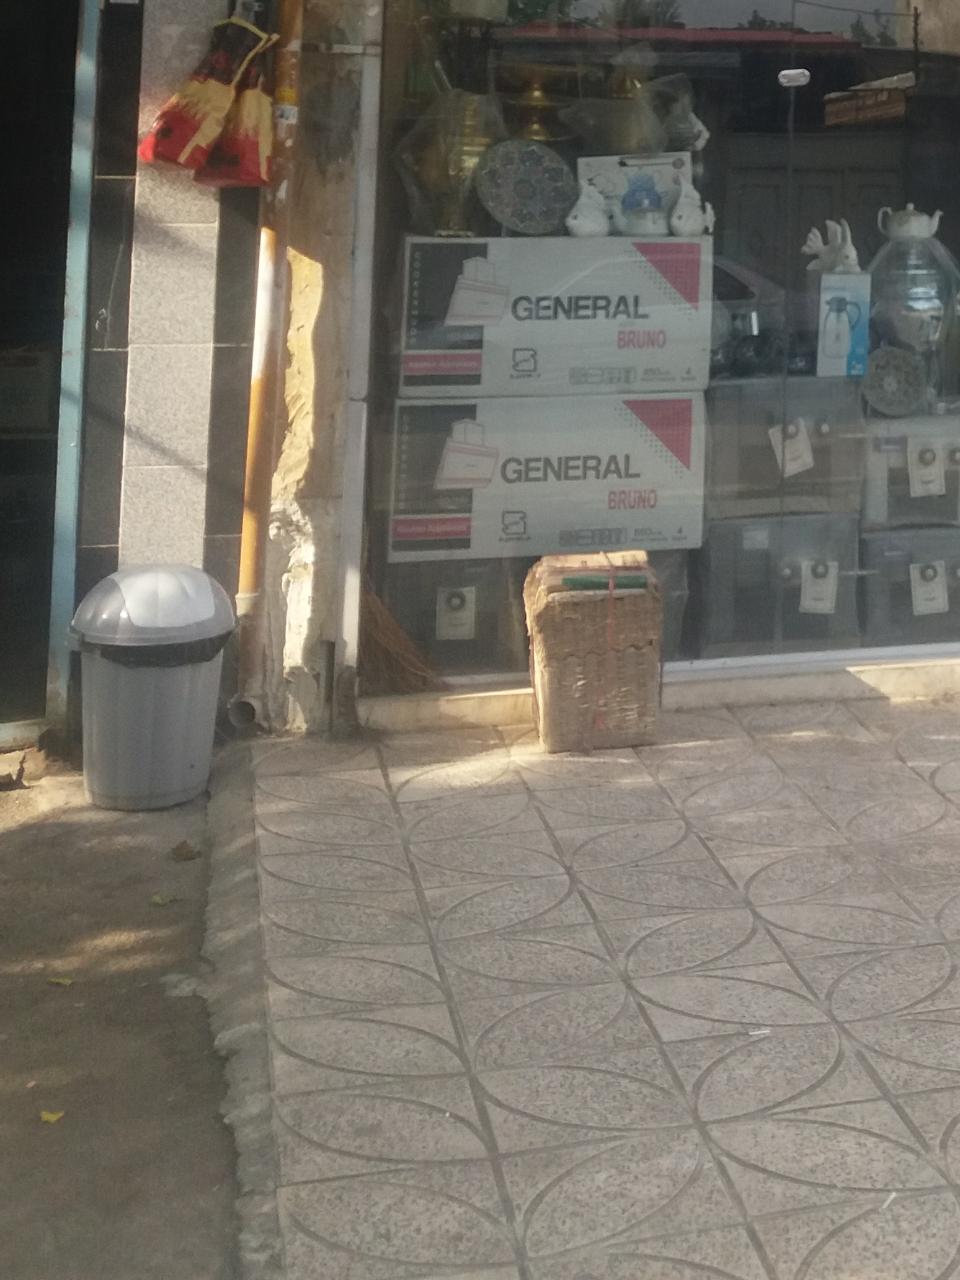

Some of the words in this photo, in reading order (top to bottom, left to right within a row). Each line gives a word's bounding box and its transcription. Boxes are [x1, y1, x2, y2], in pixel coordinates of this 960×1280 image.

[511, 294, 649, 321] GENERAL
[616, 329, 667, 350] BRUNO
[500, 453, 640, 484] GENERAL
[607, 488, 658, 510] BRUNO
